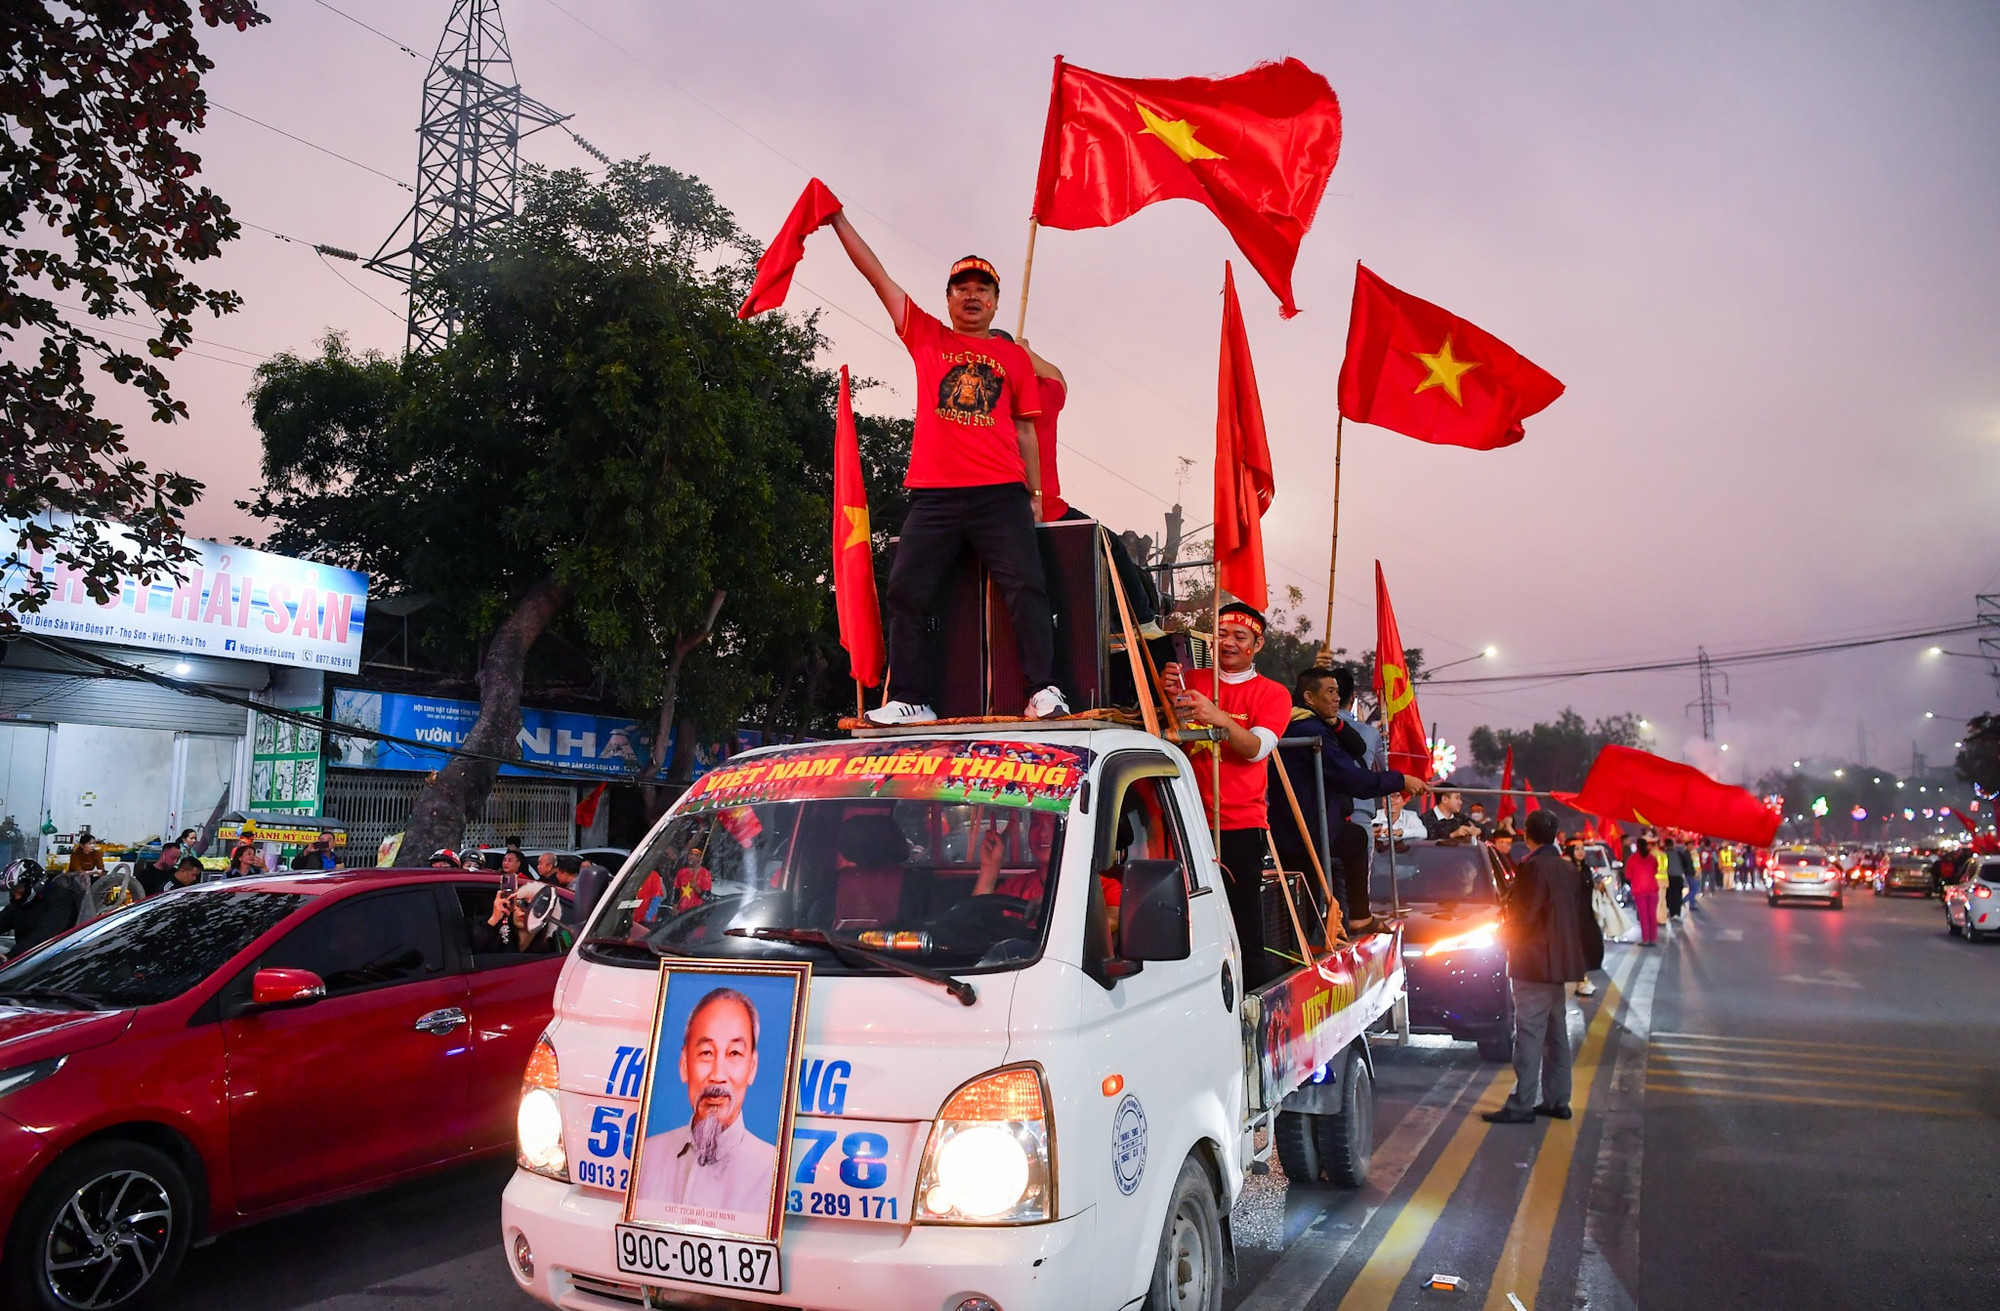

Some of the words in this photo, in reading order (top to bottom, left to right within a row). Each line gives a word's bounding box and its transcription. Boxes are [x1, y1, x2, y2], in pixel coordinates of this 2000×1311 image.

[171, 554, 252, 629] HẢI
[264, 570, 352, 644] SẢN
[34, 616, 53, 630] Diện
[70, 621, 84, 634] Vận
[85, 623, 104, 636] Động
[105, 625, 115, 636] VT
[119, 627, 132, 640] Thọ
[133, 629, 147, 640] Sơn
[152, 631, 166, 644] Việt
[195, 637, 207, 648] Thọ
[415, 726, 452, 744] VƯỜN
[765, 758, 841, 781] NAM
[844, 749, 944, 775] CHIẾN
[949, 751, 1068, 786] THẮNG
[579, 1160, 615, 1187] 0913
[810, 1192, 851, 1217] 289
[859, 1195, 897, 1220] 171
[680, 1207, 695, 1216] TỊCH
[706, 1210, 718, 1219] CHÍ
[718, 1212, 736, 1221] MINH
[623, 1231, 772, 1286] 90C-081.87
